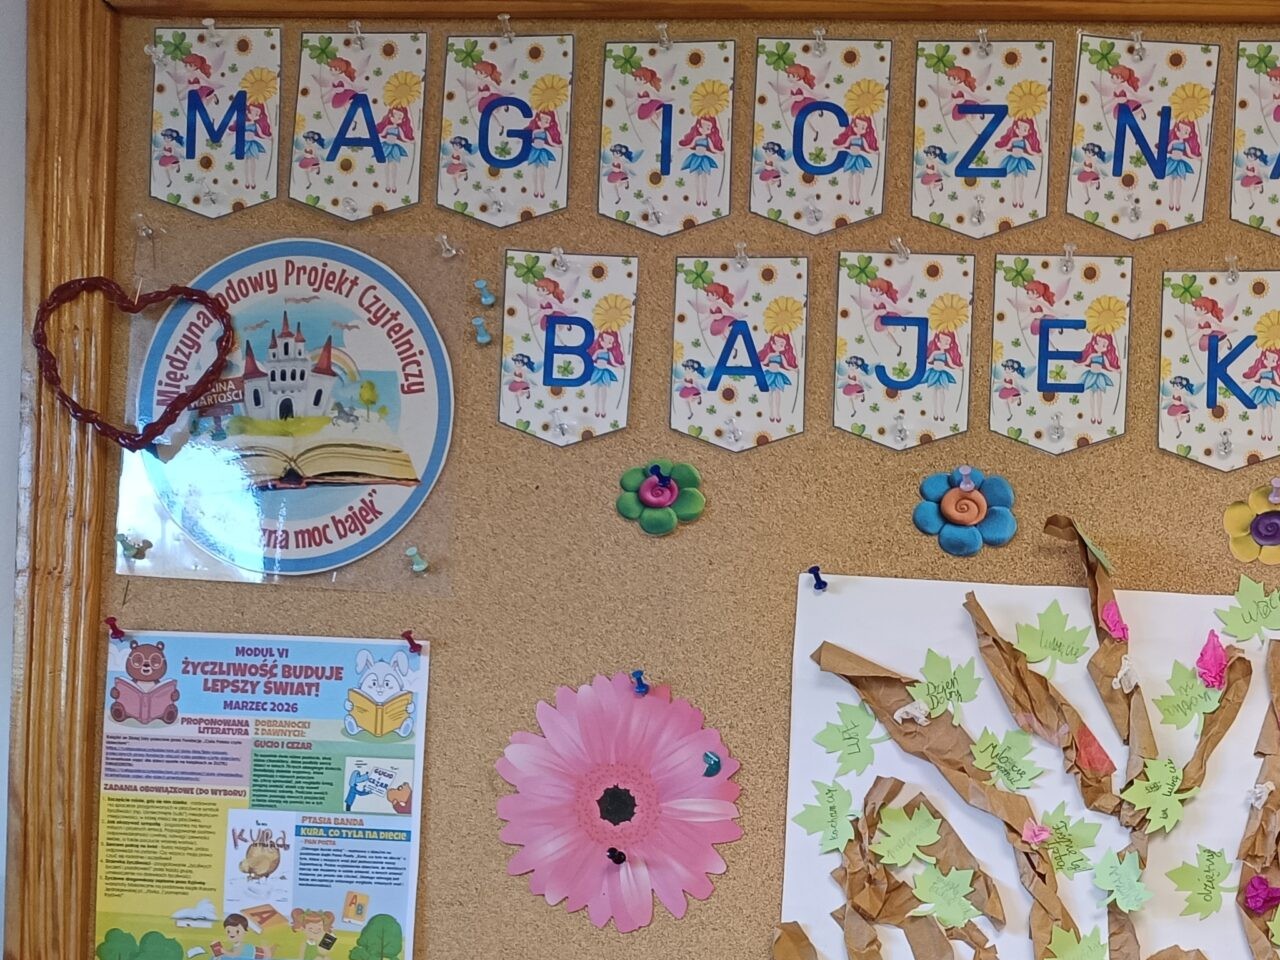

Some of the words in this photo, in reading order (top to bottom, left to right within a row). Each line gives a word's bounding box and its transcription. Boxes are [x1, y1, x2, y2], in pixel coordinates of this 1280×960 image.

[284, 259, 359, 298] Projekt
[356, 285, 425, 395] Czytelniczy
[294, 523, 333, 548] moc
[235, 646, 275, 658] MODUŁ
[277, 648, 290, 659] VI
[181, 656, 279, 678] ŻYCZLIWOŚĆ
[281, 664, 345, 681] BUDUJE
[202, 678, 261, 695] LEPSZY
[263, 675, 320, 698] ŚWIAT!
[223, 700, 268, 712] MARZEC
[269, 701, 299, 713] 2026
[180, 716, 250, 728] PROPONOWANA
[254, 718, 311, 729] DOBRANOCKI
[198, 726, 250, 736] LITERATURA
[253, 739, 280, 749] GUCIO
[286, 741, 313, 751] CEZAR
[103, 783, 138, 792] ZADANIA
[139, 786, 195, 797] OBOWIĄZKOWE
[301, 815, 332, 826] PTASIA
[333, 817, 364, 827] BANDA
[328, 828, 340, 837] CO
[365, 830, 379, 840] NA
